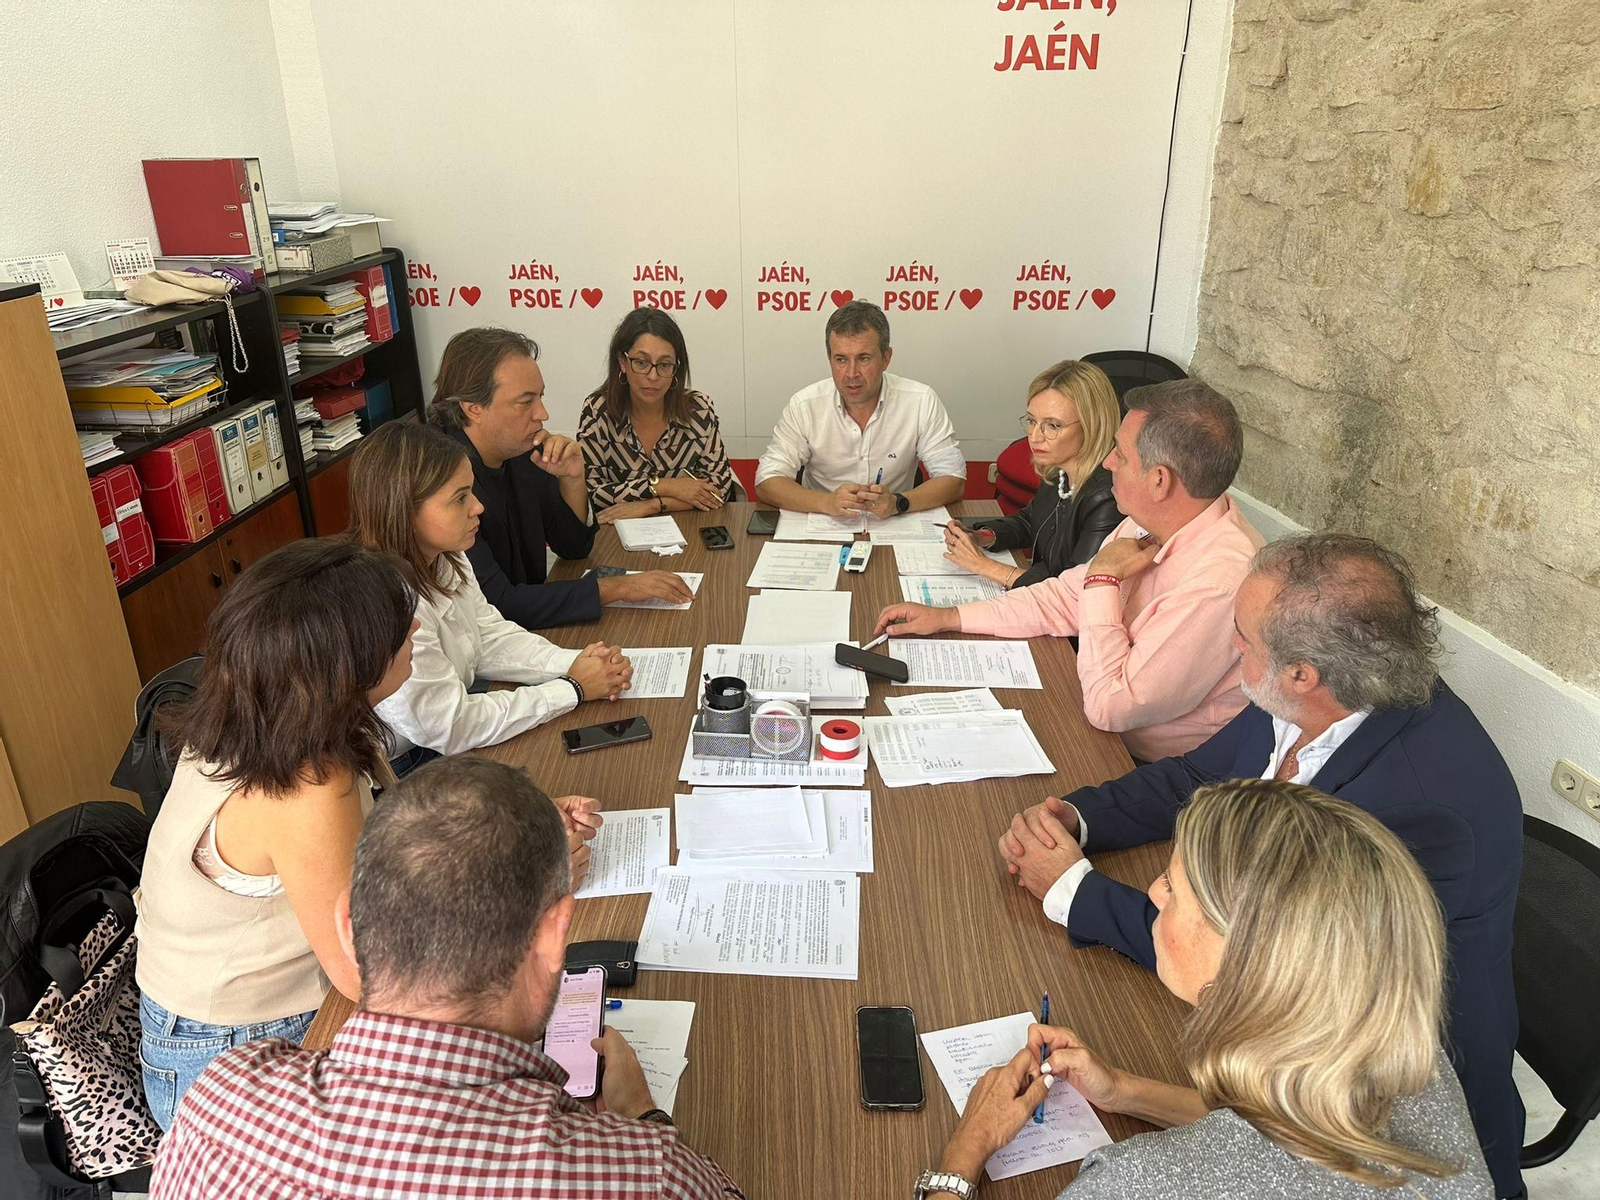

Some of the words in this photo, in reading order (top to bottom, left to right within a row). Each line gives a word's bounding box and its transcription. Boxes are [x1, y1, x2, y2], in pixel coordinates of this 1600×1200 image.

[993, 20, 1100, 72] JAÉN
[406, 259, 437, 281] ÉN,
[509, 260, 559, 283] JAÉN,
[633, 260, 684, 284] JAÉN,
[757, 261, 810, 284] JAÉN,
[885, 260, 939, 284] JAÉN,
[1016, 259, 1071, 283] JAÉN,
[408, 288, 440, 307] SOE
[509, 288, 563, 308] PSOE
[633, 290, 686, 310] PSOE
[757, 291, 811, 312] PSOE
[883, 290, 939, 311] PSOE
[1012, 290, 1070, 310] PSOE
